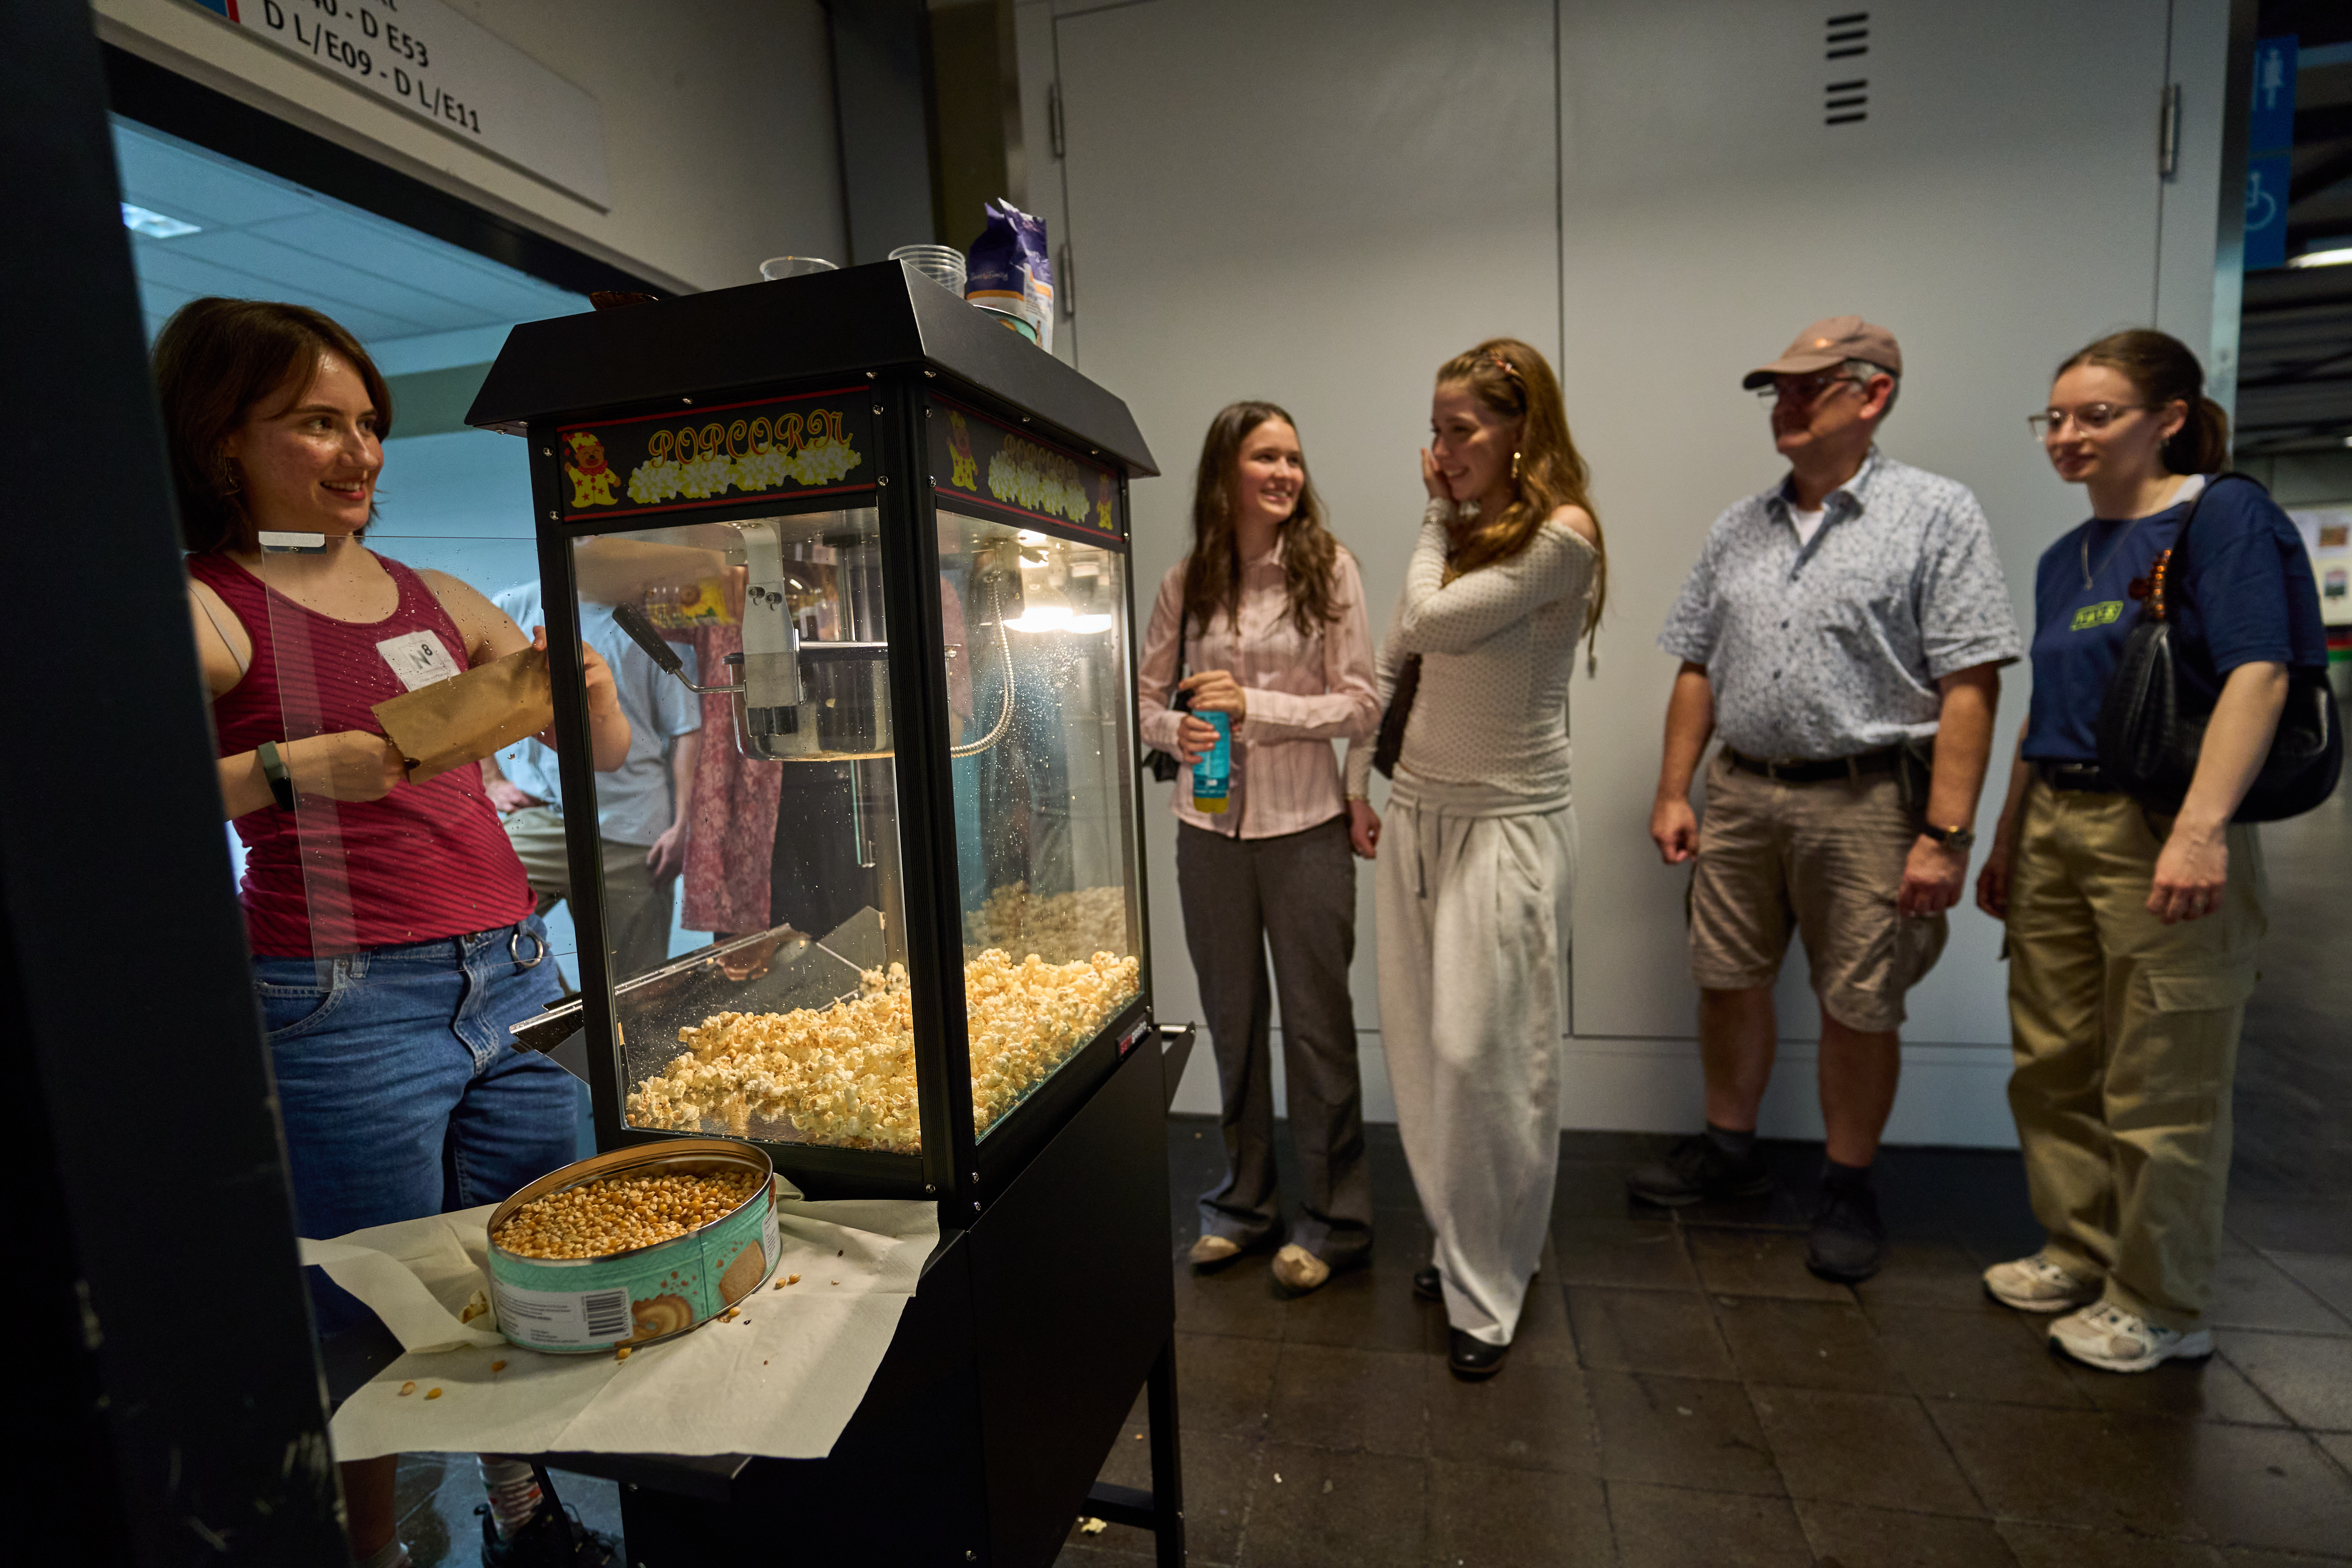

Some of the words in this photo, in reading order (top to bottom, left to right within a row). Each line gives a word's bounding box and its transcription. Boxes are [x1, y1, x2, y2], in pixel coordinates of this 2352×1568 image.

[264, 0, 285, 30] D
[294, 13, 372, 75] L/E09
[394, 67, 411, 96] D
[419, 80, 481, 134] L/E11
[360, 7, 379, 38] D
[386, 22, 428, 68] E53
[649, 409, 853, 468] POPCORN
